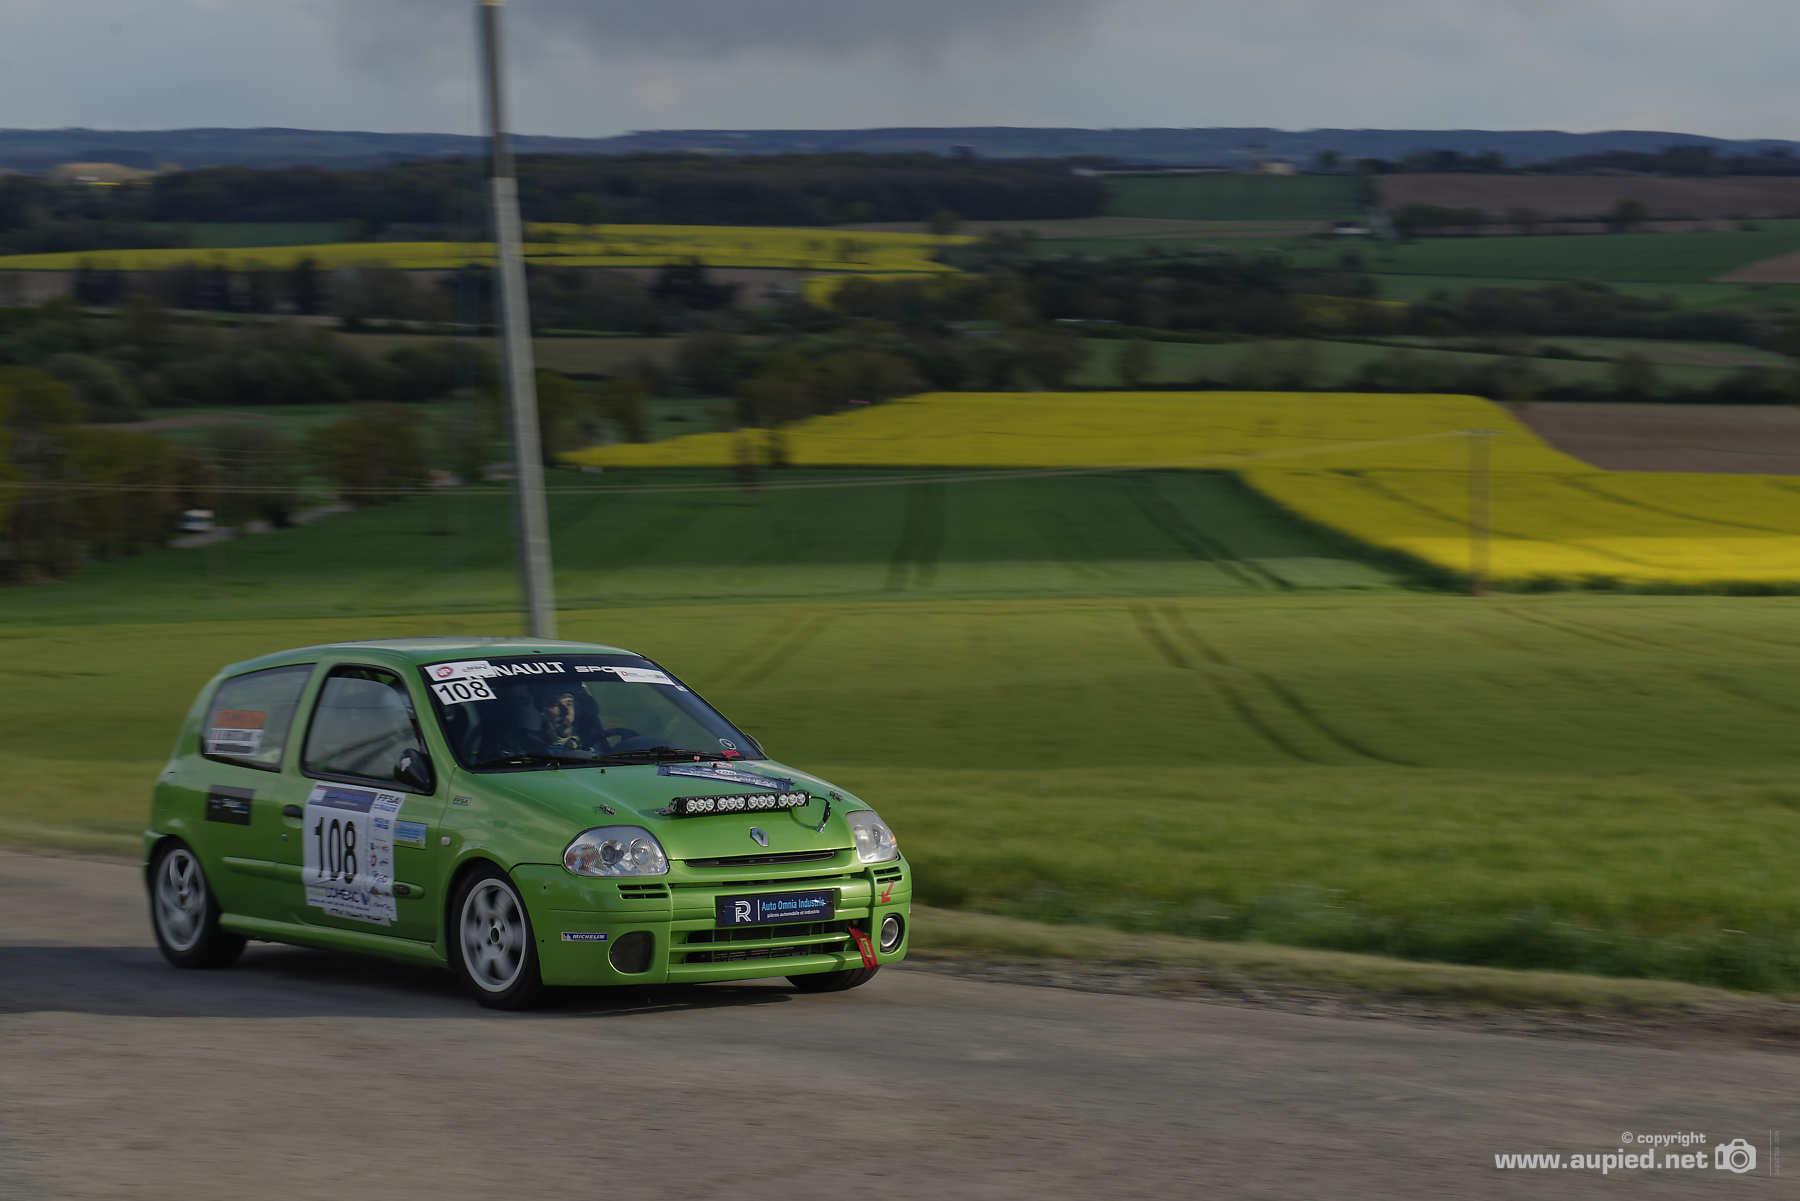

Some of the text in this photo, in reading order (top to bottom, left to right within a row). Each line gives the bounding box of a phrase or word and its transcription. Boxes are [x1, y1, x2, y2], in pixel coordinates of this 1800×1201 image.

[466, 662, 566, 679] NAULT
[439, 681, 490, 702] 108
[314, 816, 357, 884] 108
[761, 901, 777, 911] Auto
[778, 899, 797, 909] Omnia
